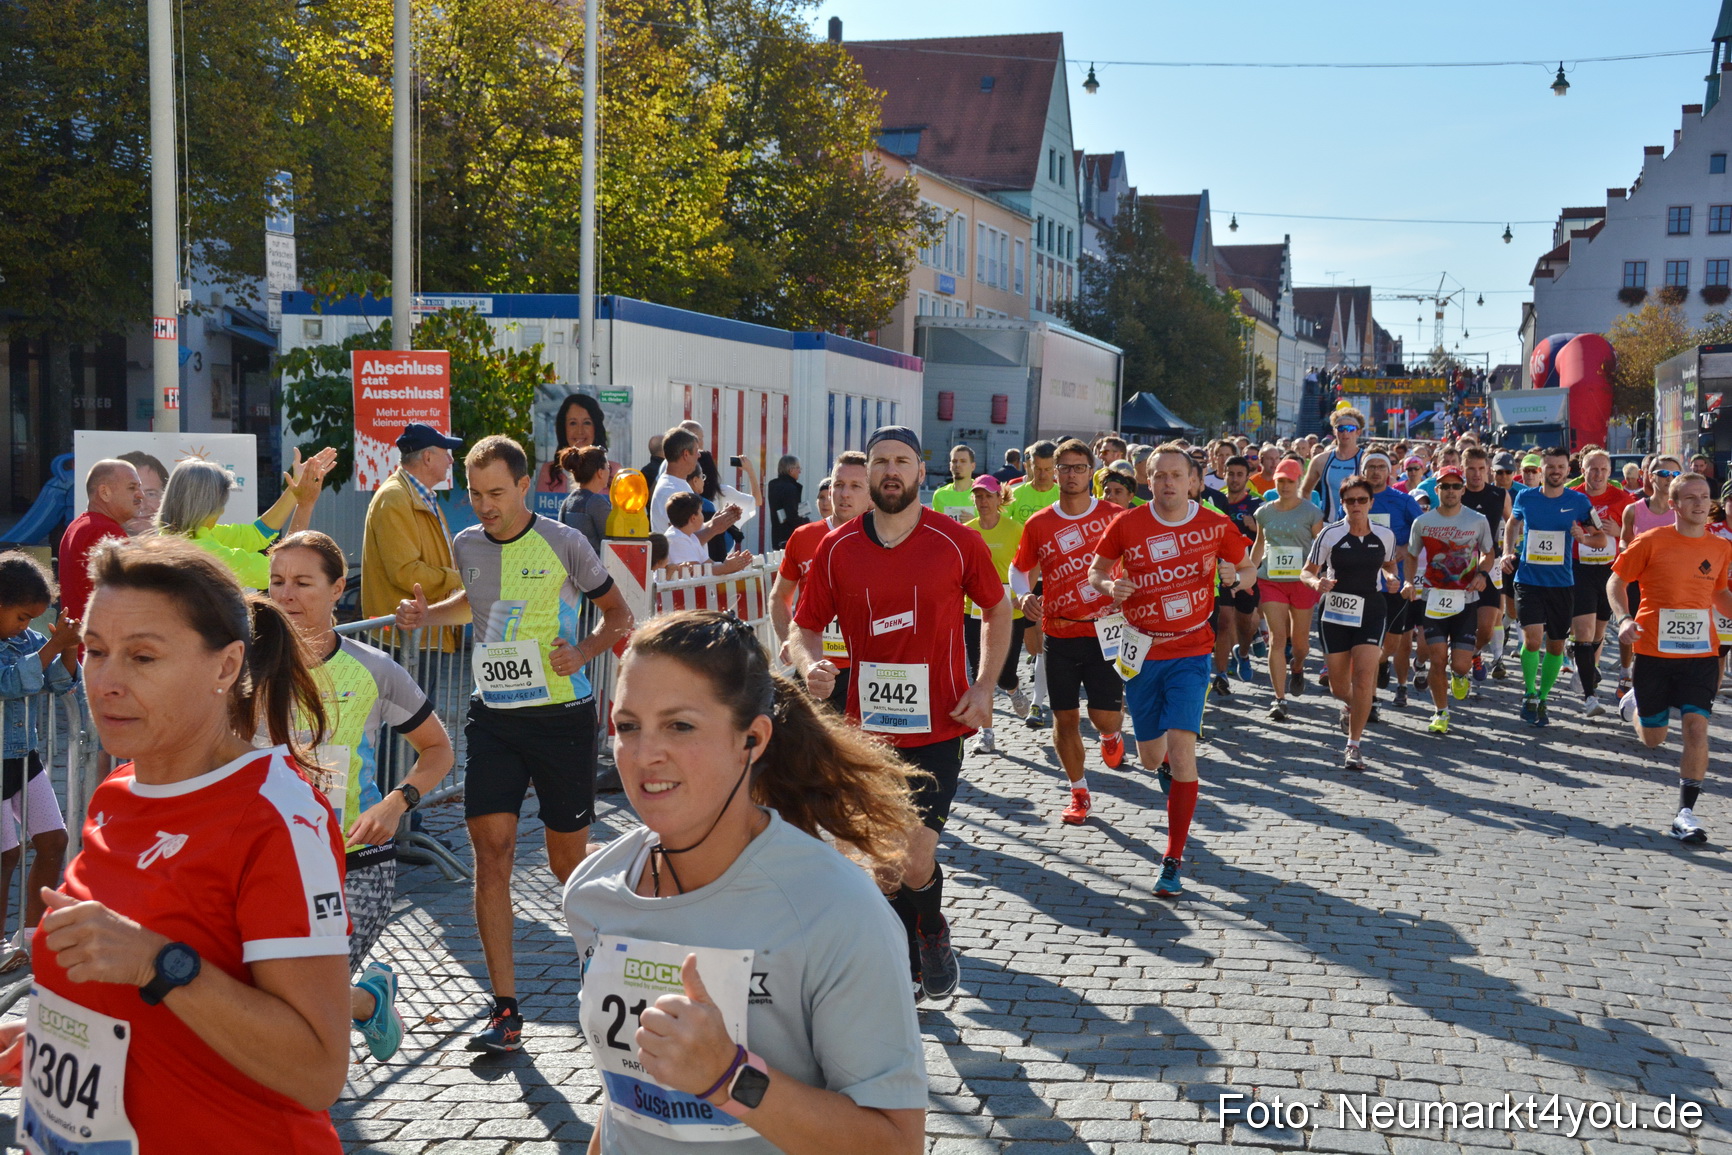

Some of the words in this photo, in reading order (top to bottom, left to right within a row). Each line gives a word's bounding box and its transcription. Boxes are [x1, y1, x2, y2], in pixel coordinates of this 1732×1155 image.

[193, 351, 203, 372] 3
[361, 360, 444, 375] Abschluss
[361, 376, 389, 386] statt
[1376, 380, 1412, 391] START
[362, 386, 445, 400] Ausschluss!
[376, 408, 400, 417] Mehr
[401, 408, 428, 417] Lehrer
[429, 408, 441, 417] für
[372, 418, 407, 427] kleinere
[1148, 535, 1174, 544] raumbox
[1538, 541, 1553, 551] 43
[1276, 555, 1294, 565] 157
[1146, 585, 1172, 595] wohnen
[1176, 577, 1199, 588] outdoor
[1163, 593, 1187, 602] raumbox
[1329, 595, 1357, 610] 3062
[1438, 597, 1453, 609] 42
[884, 618, 903, 629] DEHN
[1667, 621, 1703, 635] 2537
[488, 647, 518, 656] BOCK
[482, 658, 533, 682] 3084
[877, 669, 907, 678] BOCK
[868, 682, 918, 705] 2442
[880, 715, 908, 727] Jürgen
[624, 980, 643, 989] inspired
[644, 983, 650, 991] by
[651, 984, 667, 992] smart
[38, 1004, 90, 1042] BOCK
[622, 1058, 650, 1074] PART
[26, 1032, 102, 1120] 2304
[634, 1084, 714, 1119] Susanne
[45, 1109, 77, 1134] Neumarkt
